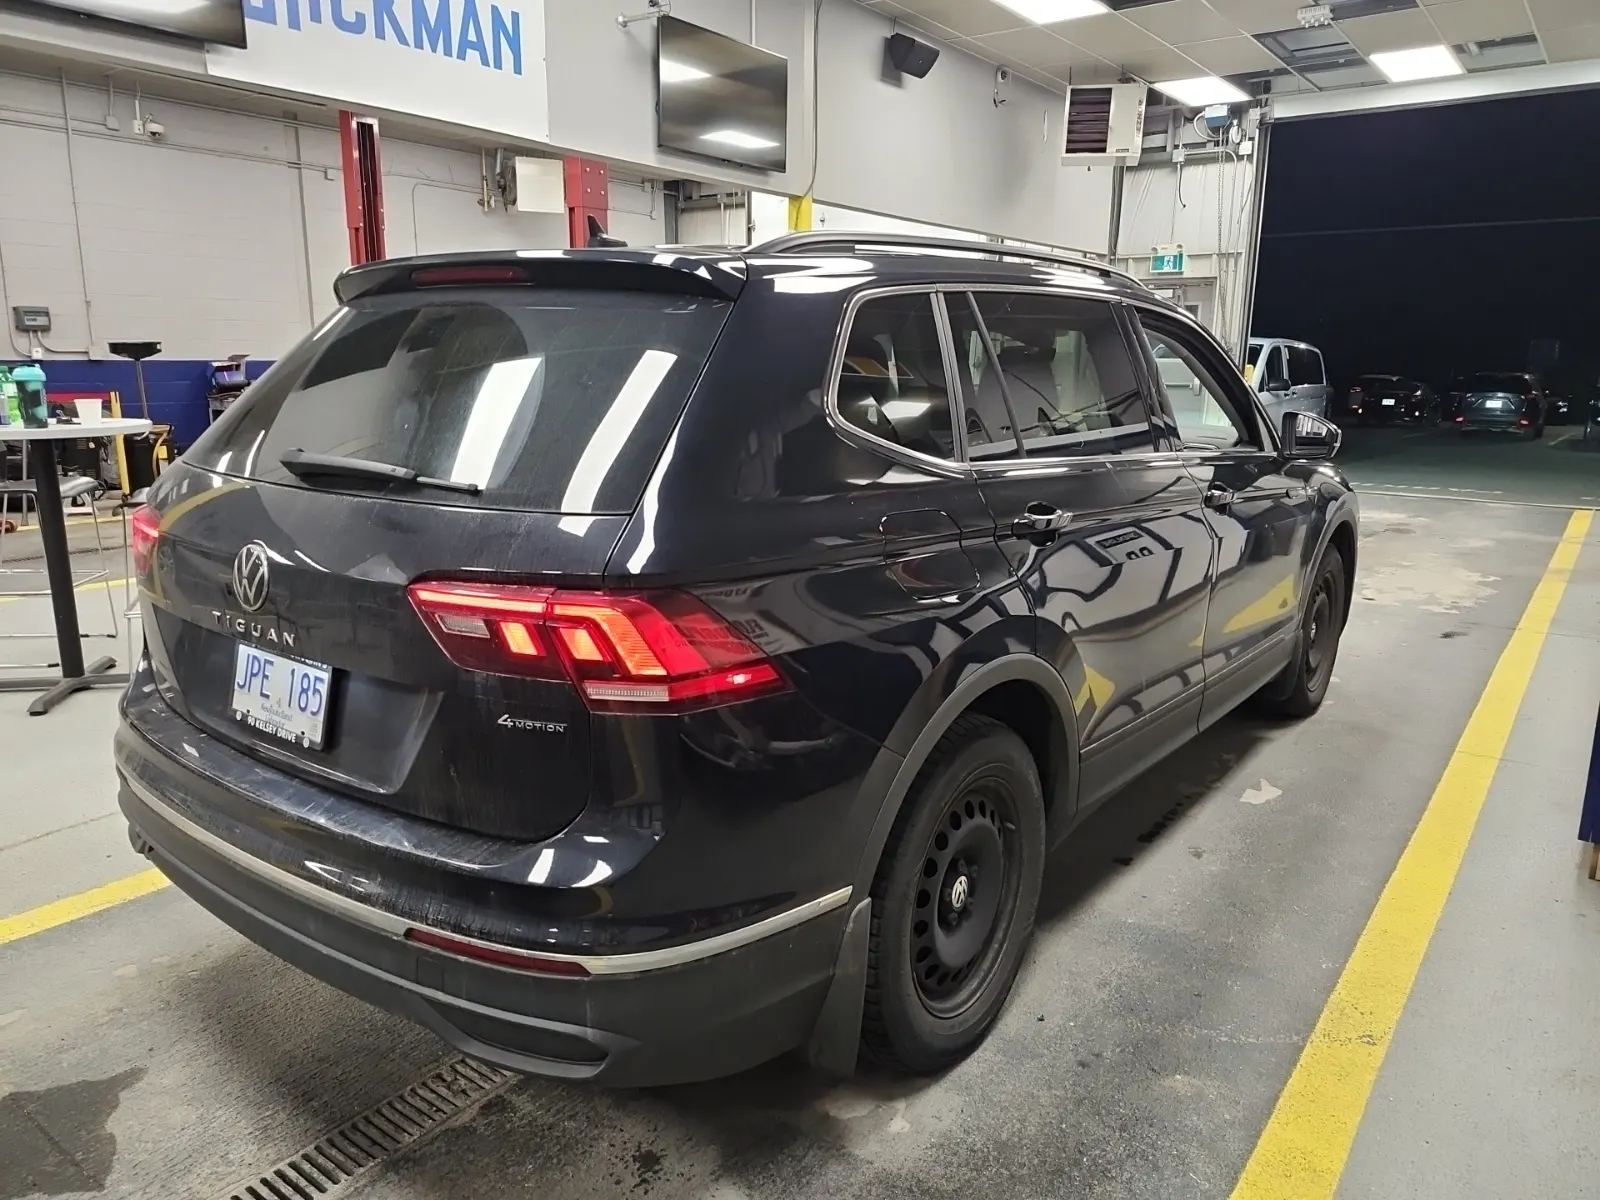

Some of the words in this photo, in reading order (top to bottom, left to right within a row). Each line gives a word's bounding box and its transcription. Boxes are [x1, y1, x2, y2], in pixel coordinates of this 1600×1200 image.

[212, 610, 295, 647] TIGUAN
[236, 653, 274, 700] JPE
[288, 667, 326, 717] 185
[247, 715, 256, 727] 90
[255, 718, 278, 735] KELSEY
[276, 727, 297, 743] DRIVE
[497, 714, 567, 732] 4MOTION
